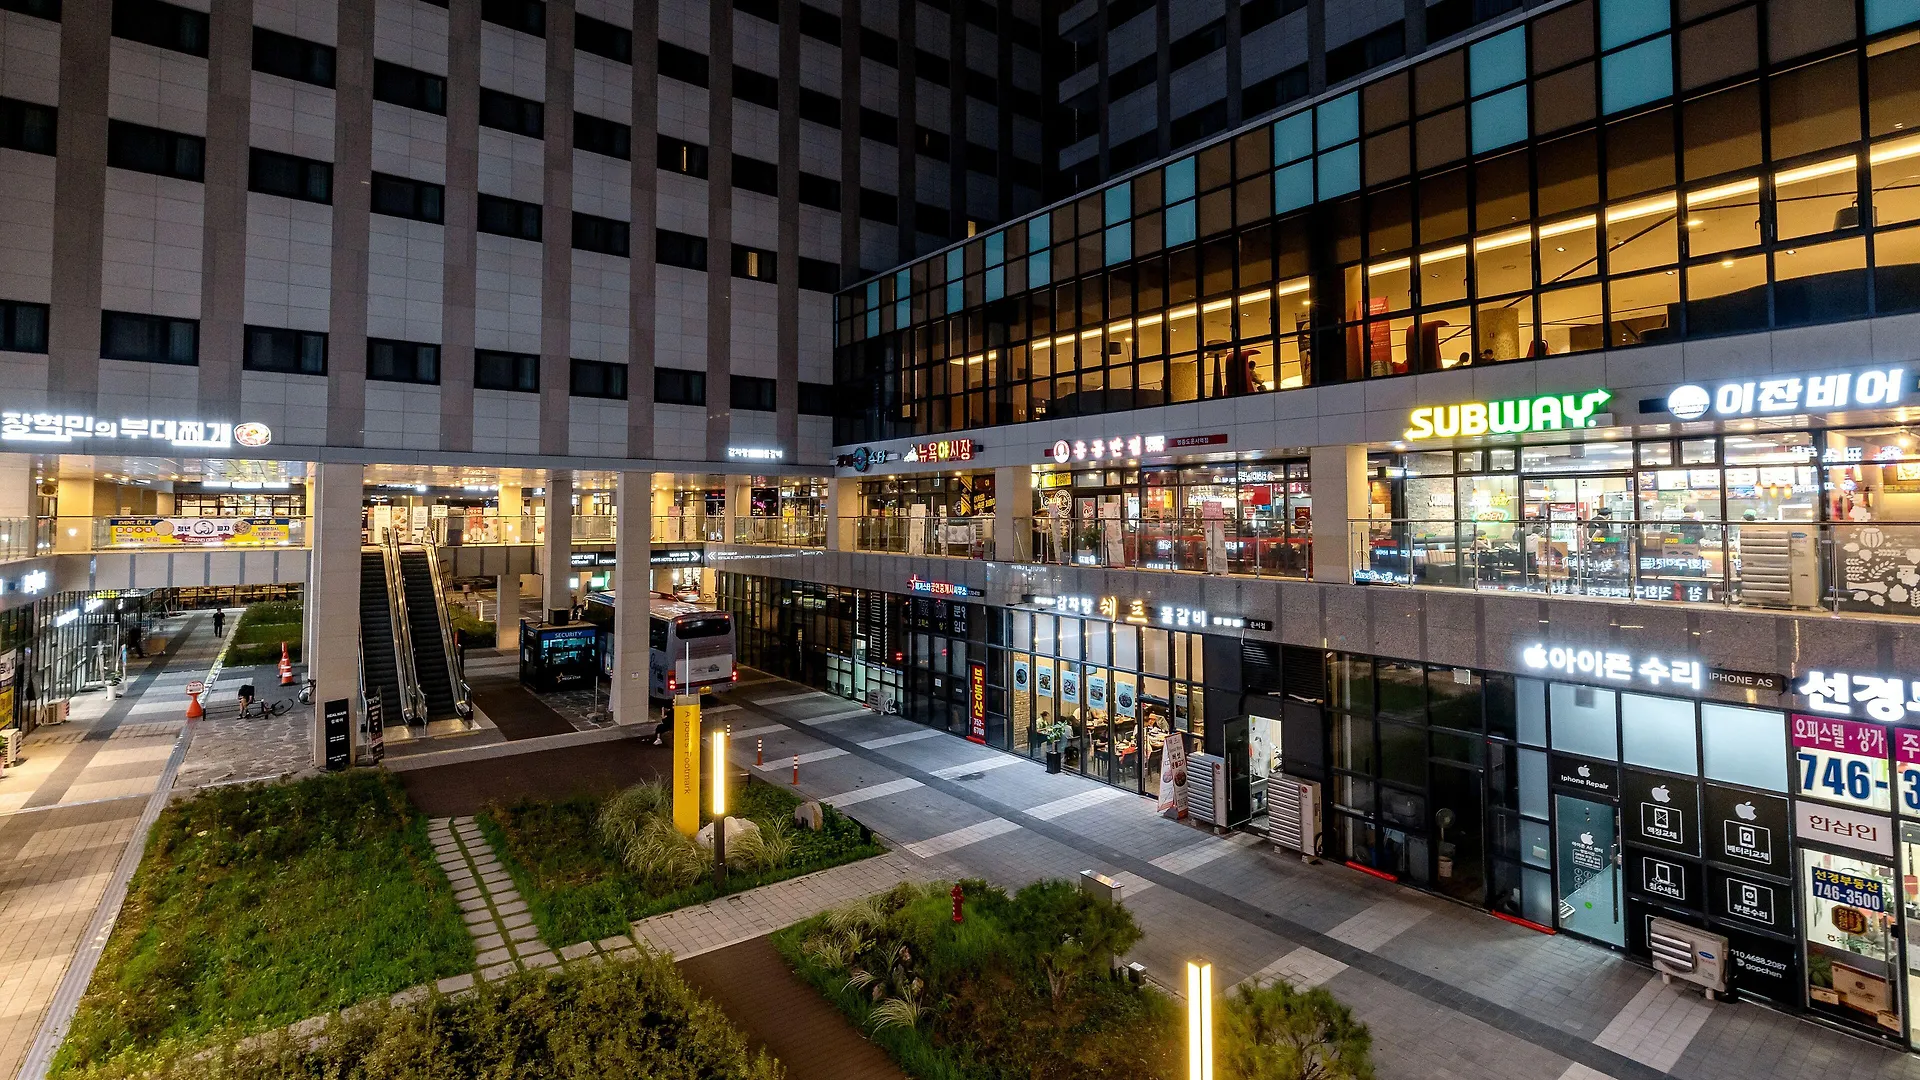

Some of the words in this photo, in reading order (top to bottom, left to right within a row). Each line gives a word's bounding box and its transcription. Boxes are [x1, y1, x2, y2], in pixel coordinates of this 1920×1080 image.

[1716, 369, 1904, 415] 이잔비어
[1403, 388, 1612, 441] SUBWAY
[120, 418, 231, 443] 부대찌개
[918, 439, 972, 463] 뉴욕야시장
[554, 631, 583, 639] SECURITY
[1550, 648, 1634, 681] 아이폰
[1638, 657, 1701, 690] 수리
[1708, 671, 1753, 686] IPHONE
[1756, 677, 1774, 688] AS
[974, 668, 983, 717] 부동산
[1795, 718, 1845, 749] 오피스텔
[1857, 727, 1885, 754] 상가
[1561, 774, 1585, 786] Iphone
[1586, 779, 1609, 790] Repair
[1647, 826, 1678, 839] 액정교체
[1809, 814, 1877, 842] 한삼인
[1727, 845, 1769, 861] 배터리교체
[1815, 869, 1879, 893] 선경부동산
[1815, 882, 1880, 911] 746-3500
[1733, 904, 1768, 920] 부분수리
